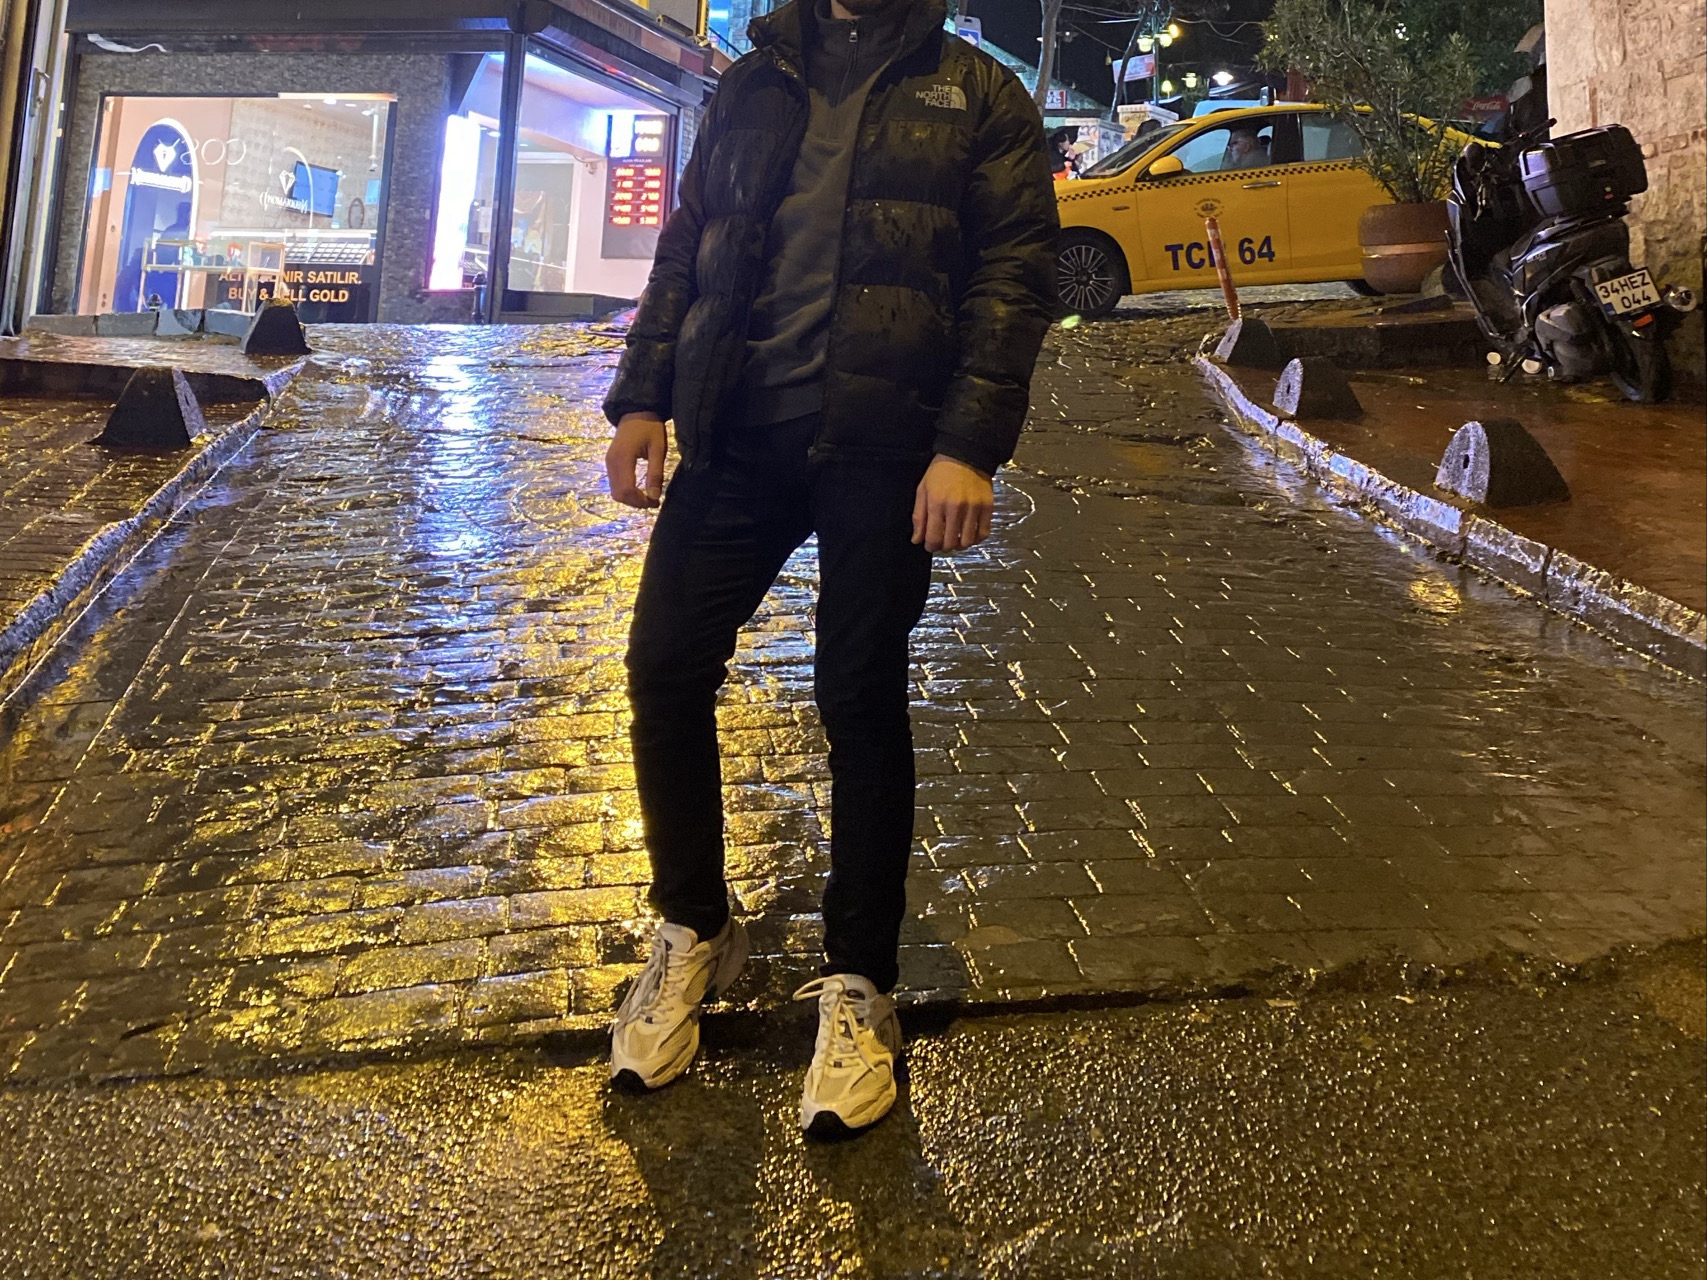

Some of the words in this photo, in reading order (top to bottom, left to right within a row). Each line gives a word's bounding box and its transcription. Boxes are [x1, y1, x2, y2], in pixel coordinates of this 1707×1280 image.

[915, 91, 952, 101] NORTH
[932, 84, 952, 93] THE
[925, 99, 951, 108] FACE
[1238, 235, 1275, 265] 64
[1599, 272, 1651, 299] 34HEZ
[259, 288, 269, 301] &
[309, 289, 349, 303] GOLD
[1620, 290, 1652, 309] 044
